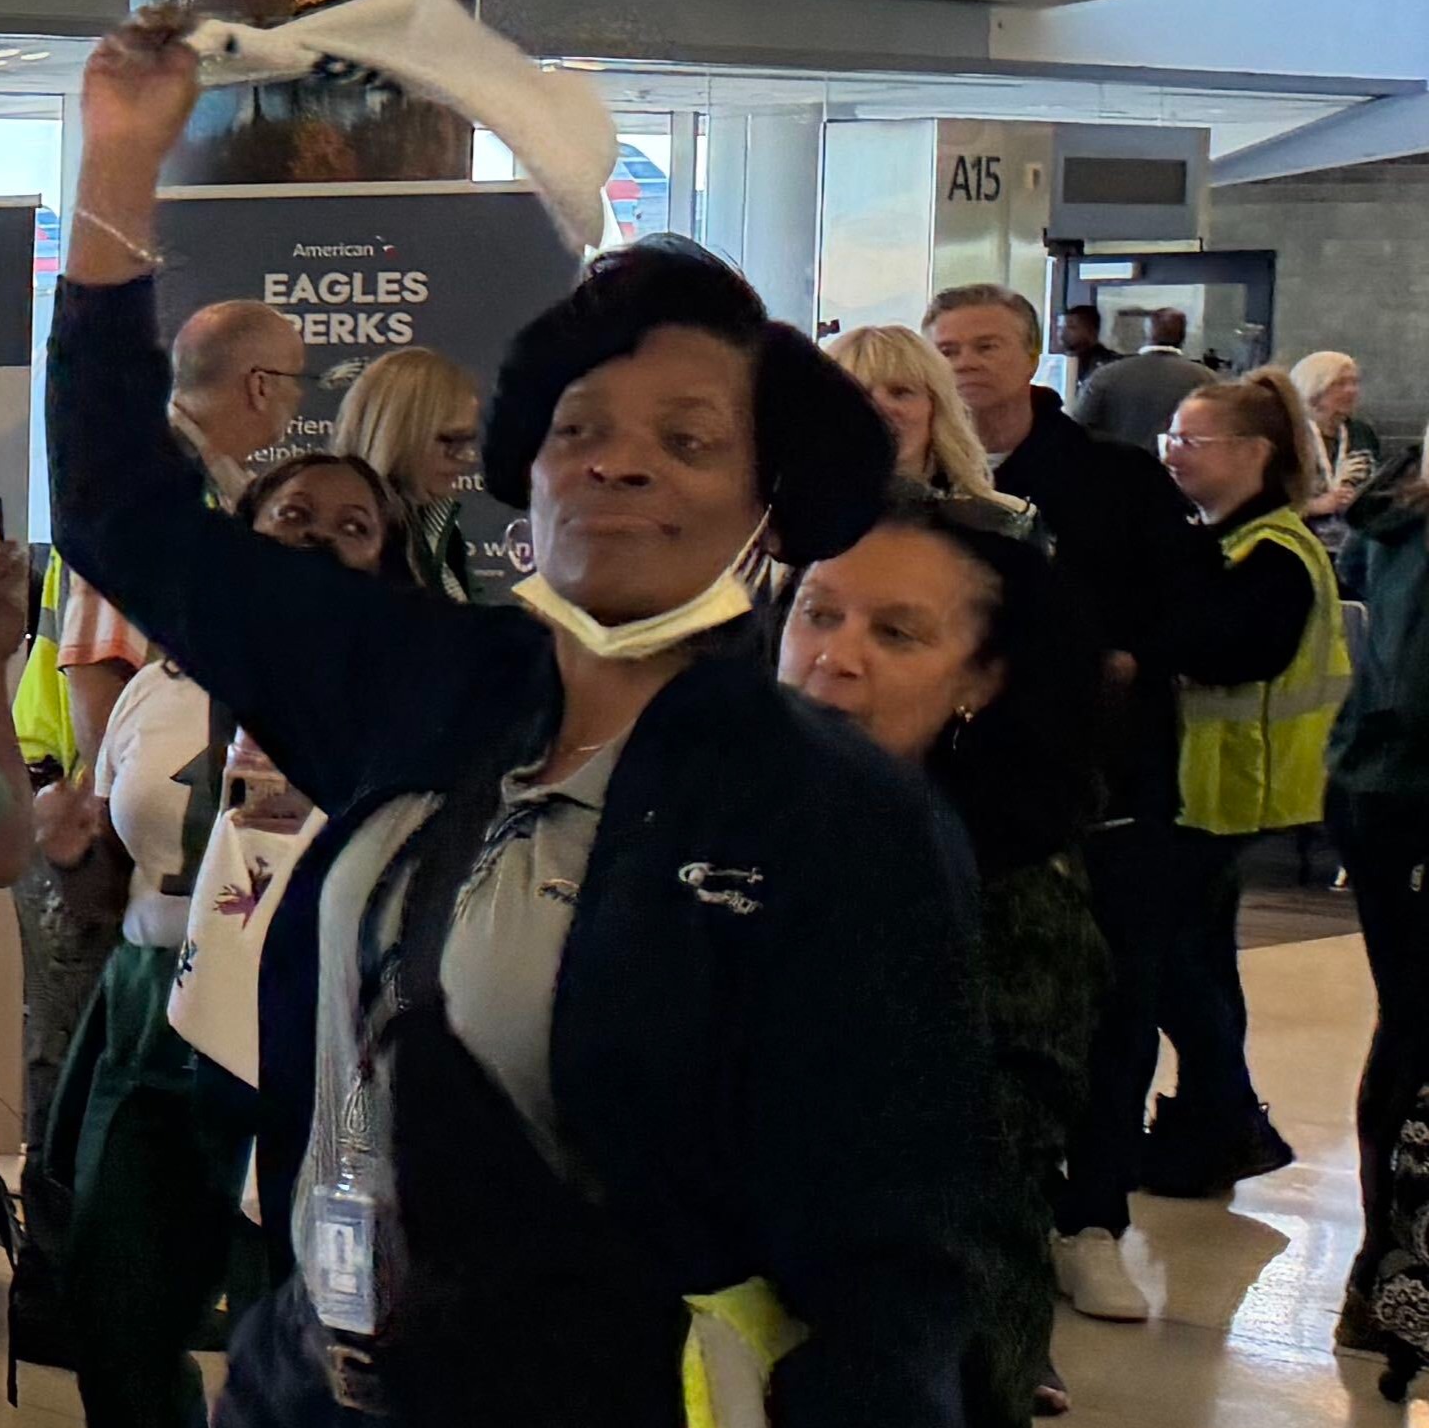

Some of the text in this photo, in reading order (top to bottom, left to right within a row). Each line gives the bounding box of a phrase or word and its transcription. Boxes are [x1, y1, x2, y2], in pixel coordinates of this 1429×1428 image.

[948, 155, 1001, 202] A15
[293, 241, 375, 258] American
[264, 271, 430, 305] EAGLES
